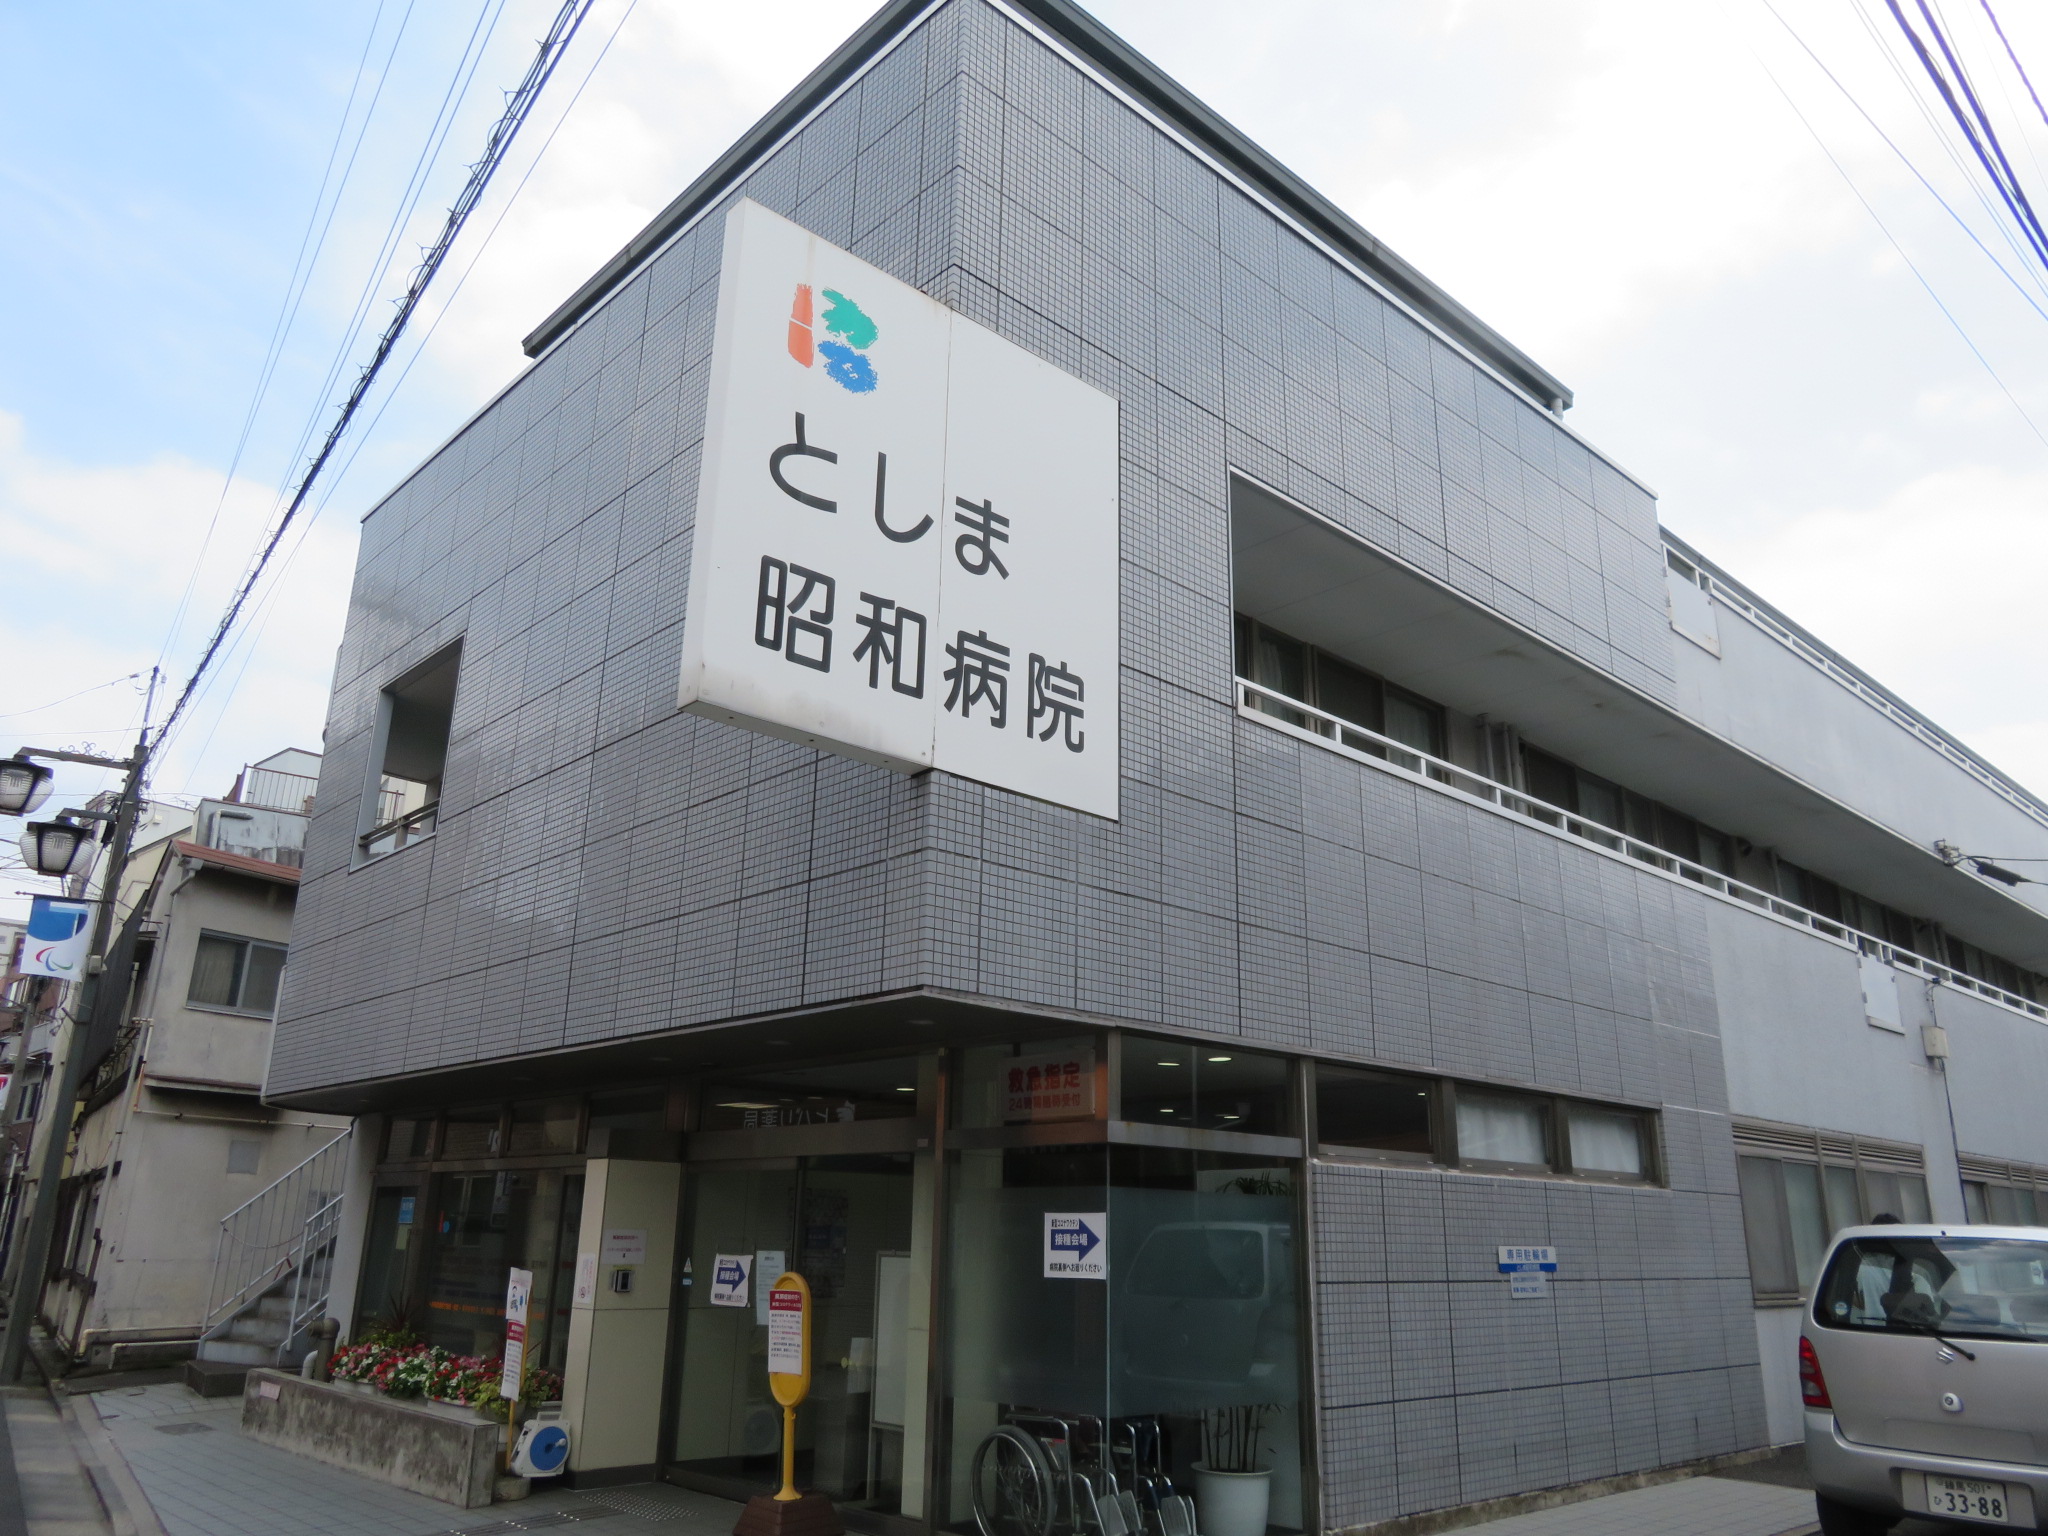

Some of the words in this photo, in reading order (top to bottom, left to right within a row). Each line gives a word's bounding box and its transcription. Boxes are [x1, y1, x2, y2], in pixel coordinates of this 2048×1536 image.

[769, 411, 1010, 580] としま
[755, 554, 1086, 754] 昭和病院
[1008, 1061, 1081, 1093] 救急指定
[1055, 1233, 1087, 1246] 接種会場
[1945, 1493, 2002, 1517] 33-88
